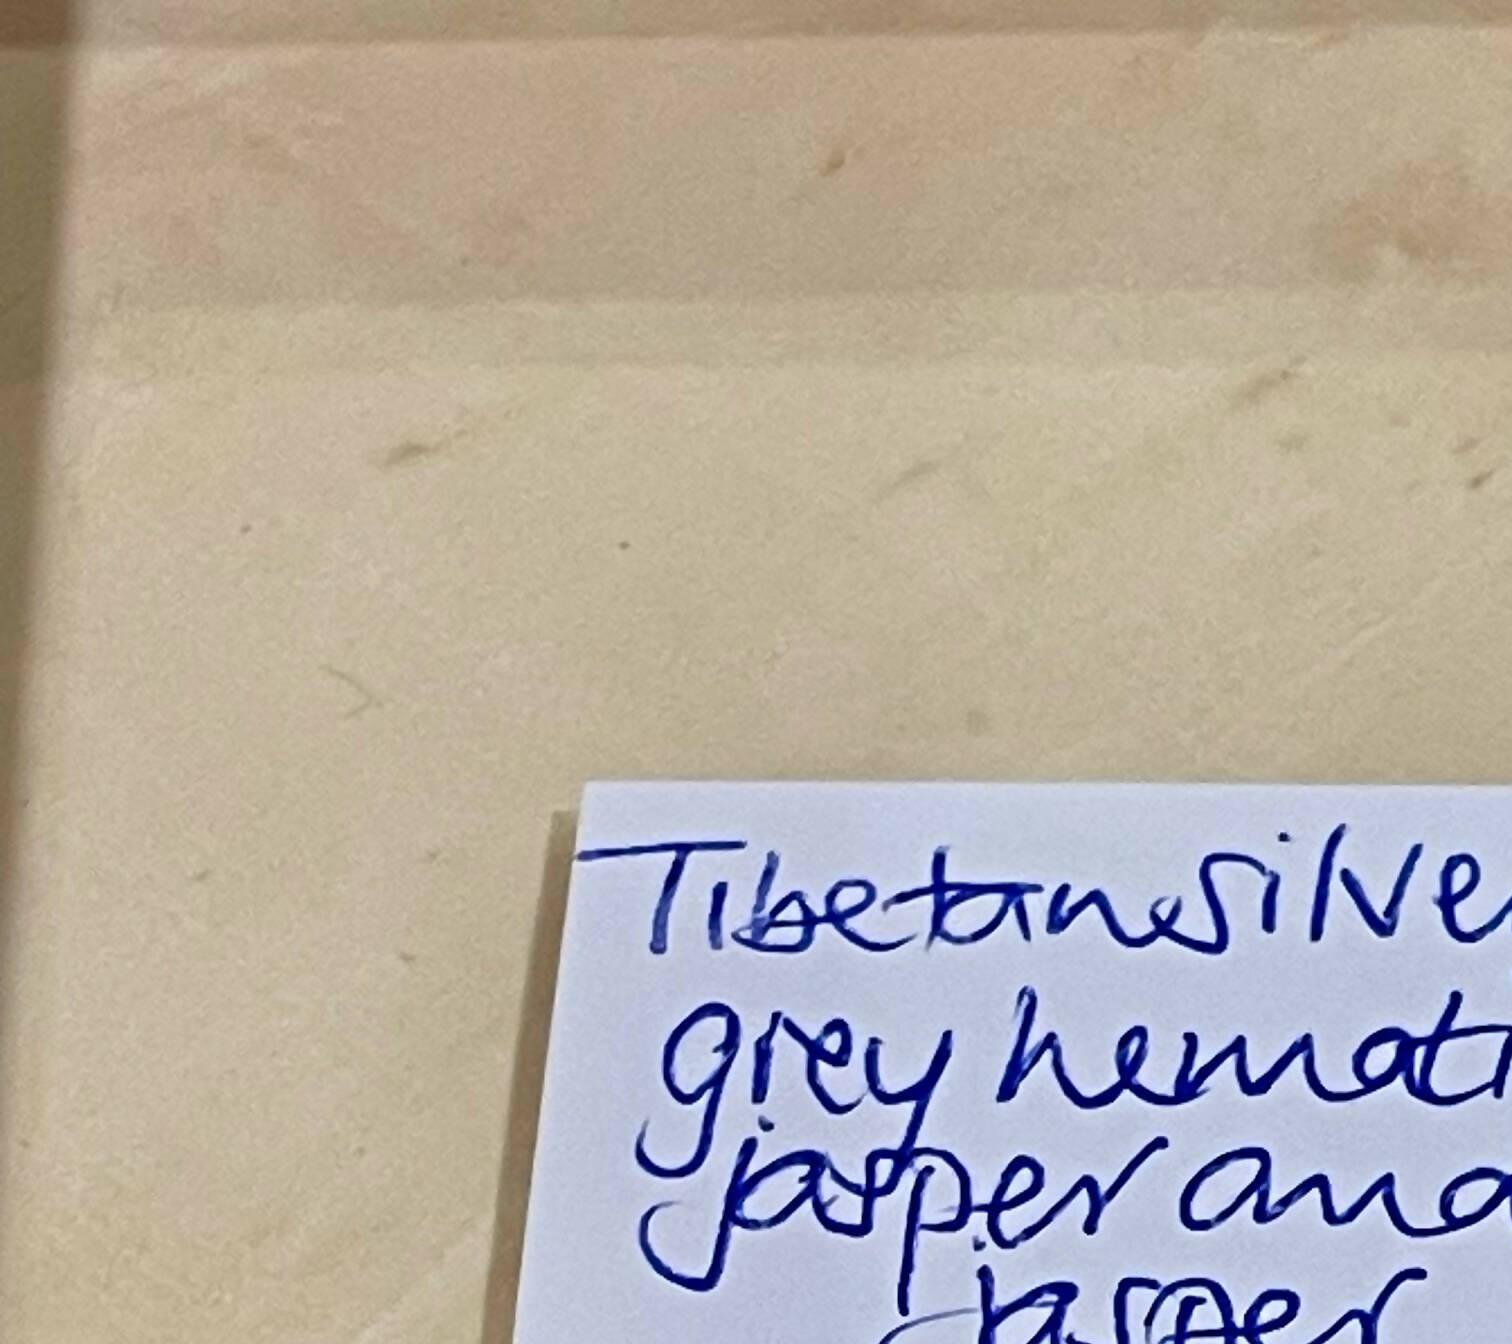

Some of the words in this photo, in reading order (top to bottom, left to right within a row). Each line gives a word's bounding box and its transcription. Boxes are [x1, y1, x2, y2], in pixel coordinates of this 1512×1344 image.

[575, 840, 1147, 954] Tibetan
[634, 1001, 954, 1179] grey
[638, 1117, 1171, 1318] jasper
